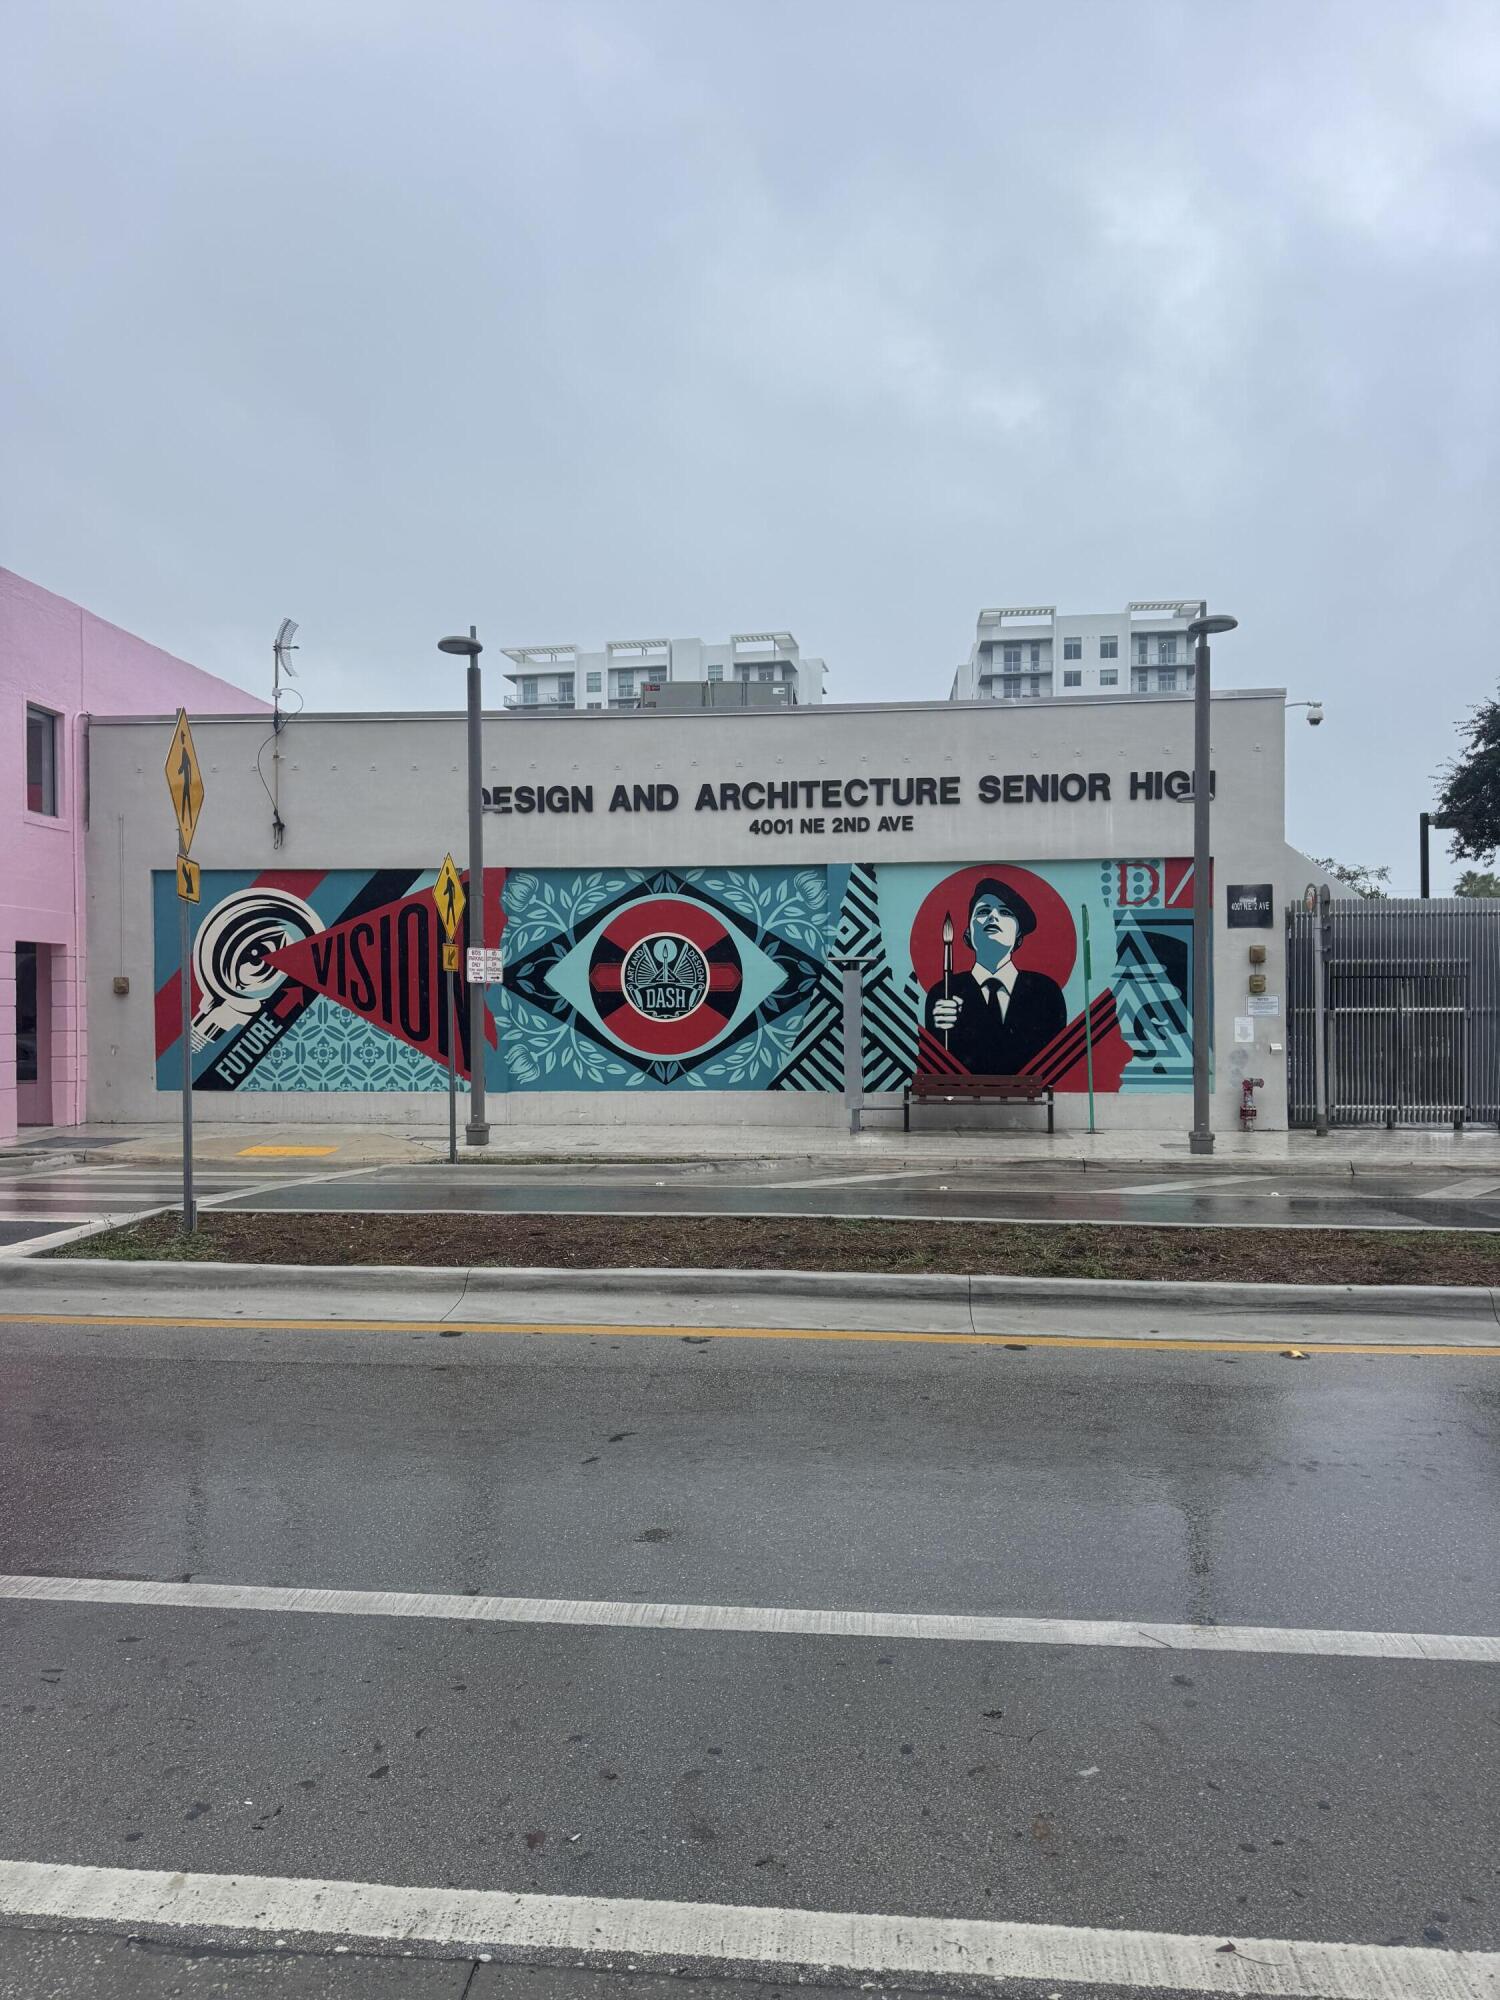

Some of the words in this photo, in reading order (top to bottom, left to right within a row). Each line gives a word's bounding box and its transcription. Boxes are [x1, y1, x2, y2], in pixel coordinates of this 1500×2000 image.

[609, 784, 679, 812] AND
[695, 776, 961, 811] ARCHITECTURE
[978, 772, 1111, 803] SENIOR
[750, 819, 794, 835] 4001
[800, 818, 825, 834] NE
[832, 817, 870, 833] 2ND
[877, 816, 914, 832] AVE
[1254, 902, 1258, 911] 2
[1259, 901, 1270, 911] AVE
[627, 966, 635, 981] ART
[633, 949, 644, 966] AND
[688, 949, 705, 982] DESIGN
[646, 987, 686, 1009] DASH
[215, 1011, 283, 1085] FUTURE
